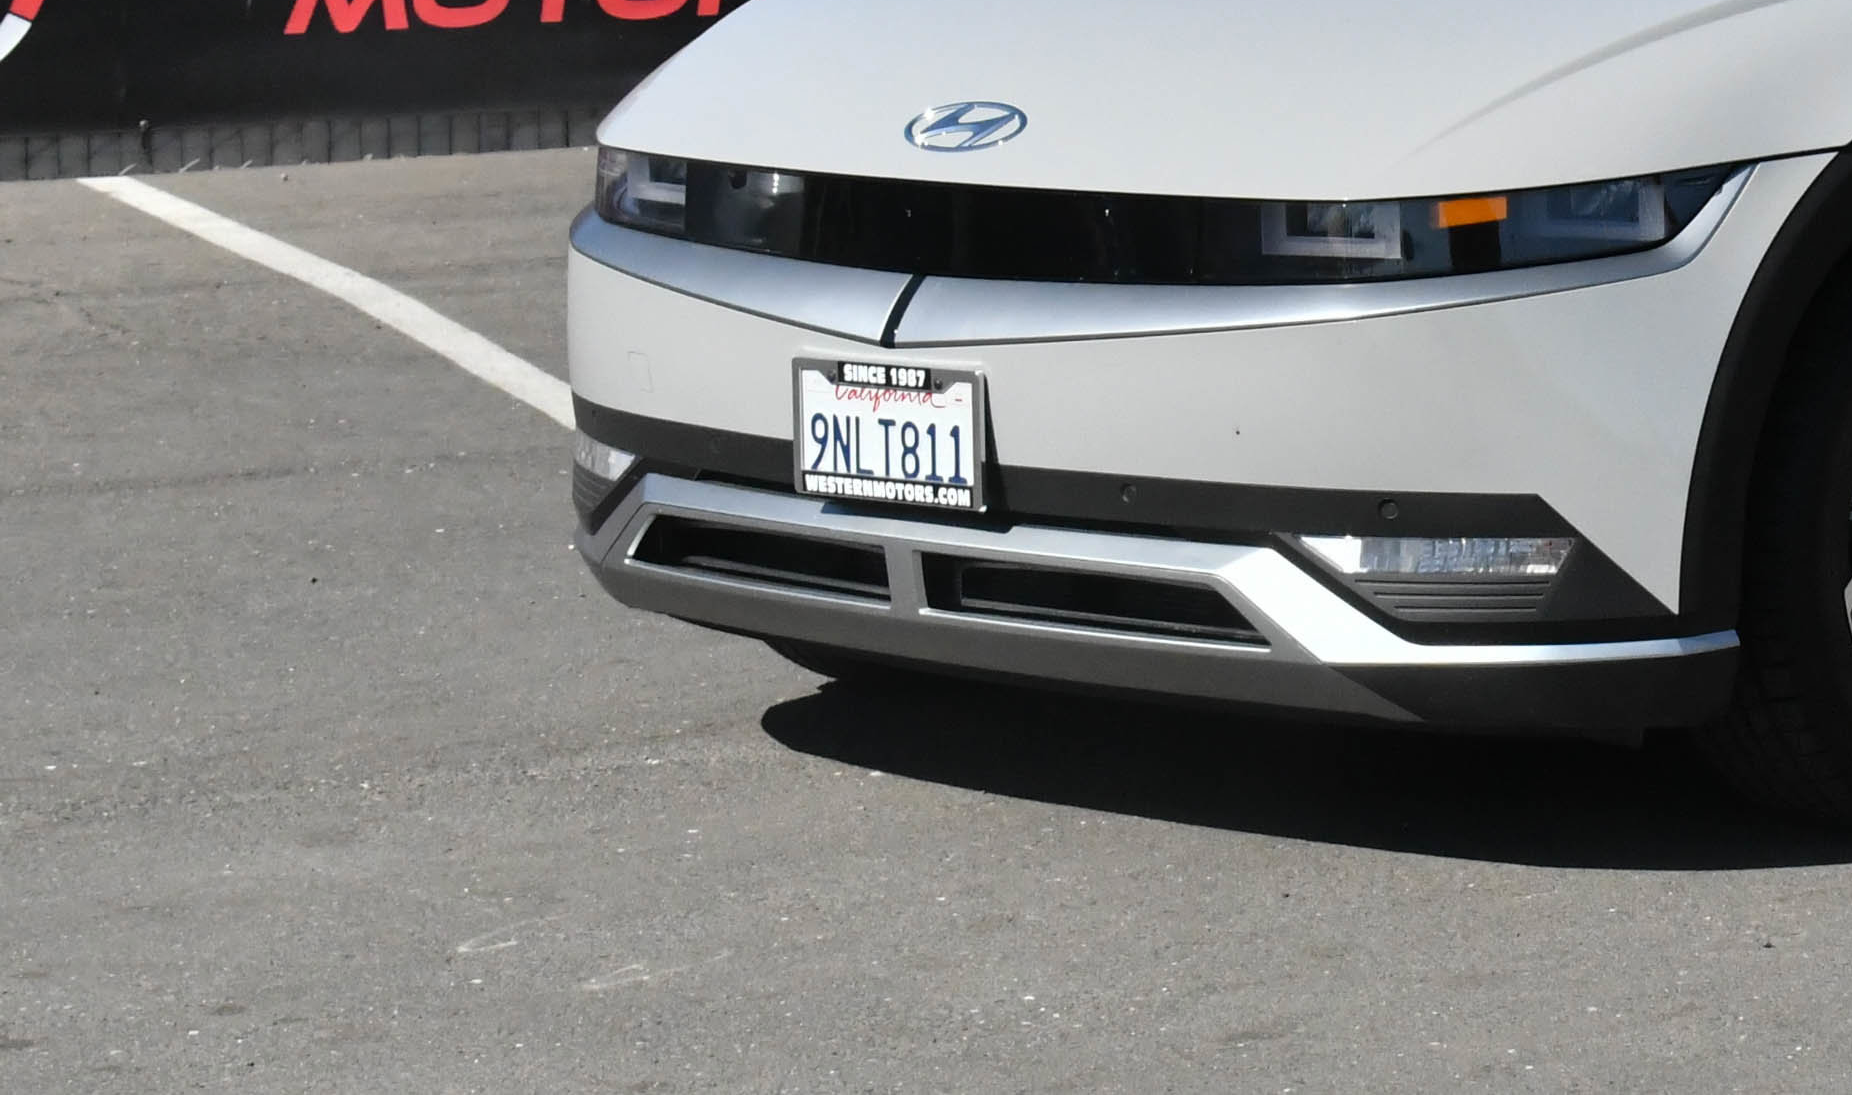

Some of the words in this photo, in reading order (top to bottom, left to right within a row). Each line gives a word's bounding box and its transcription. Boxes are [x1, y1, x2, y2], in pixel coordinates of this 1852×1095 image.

[843, 363, 887, 385] SINCE
[889, 366, 926, 388] 1987
[810, 412, 968, 485] 9NLT811
[804, 473, 972, 508] WESTERNMOTORS.COM
